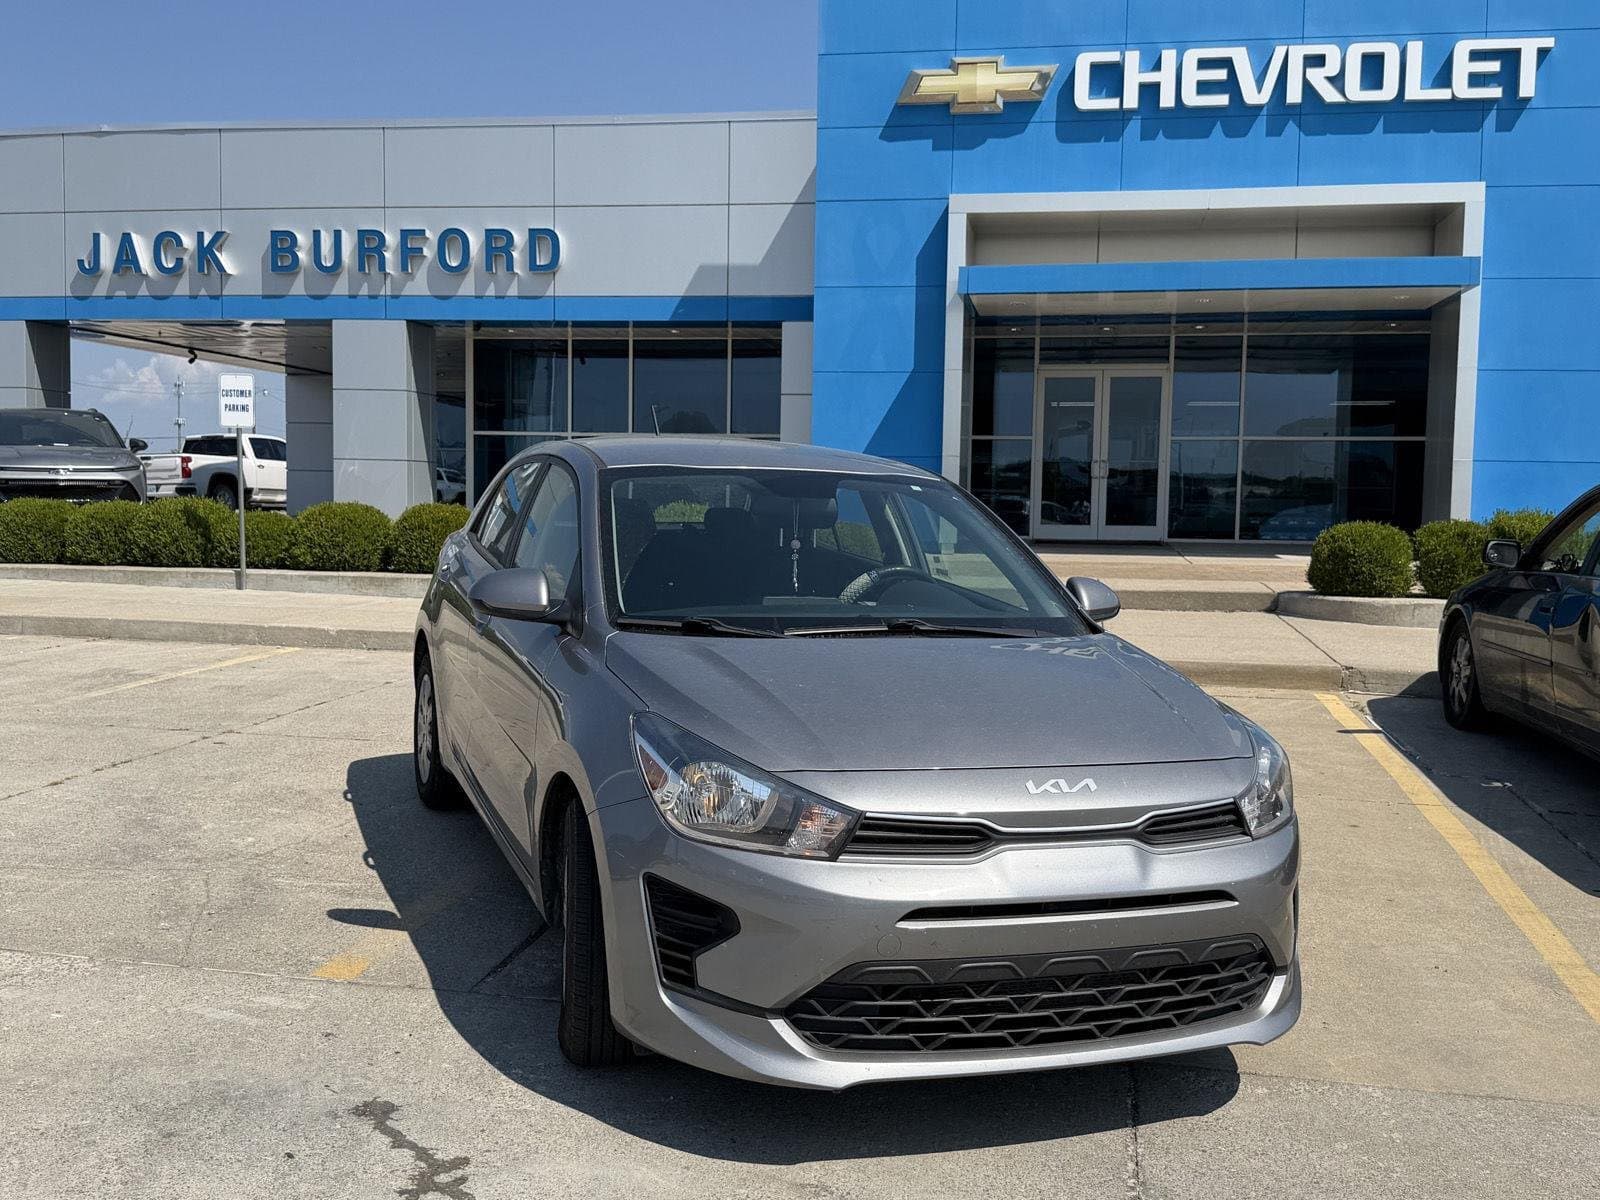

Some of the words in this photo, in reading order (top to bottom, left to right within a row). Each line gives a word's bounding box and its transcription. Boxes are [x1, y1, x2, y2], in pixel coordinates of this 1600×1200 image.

[1074, 36, 1556, 111] CHEVROLET
[77, 230, 230, 277] JACK
[269, 227, 562, 275] BURFORD
[221, 388, 252, 398] CUSTOMER
[224, 403, 250, 413] PARKING
[1025, 778, 1098, 795] KIA
